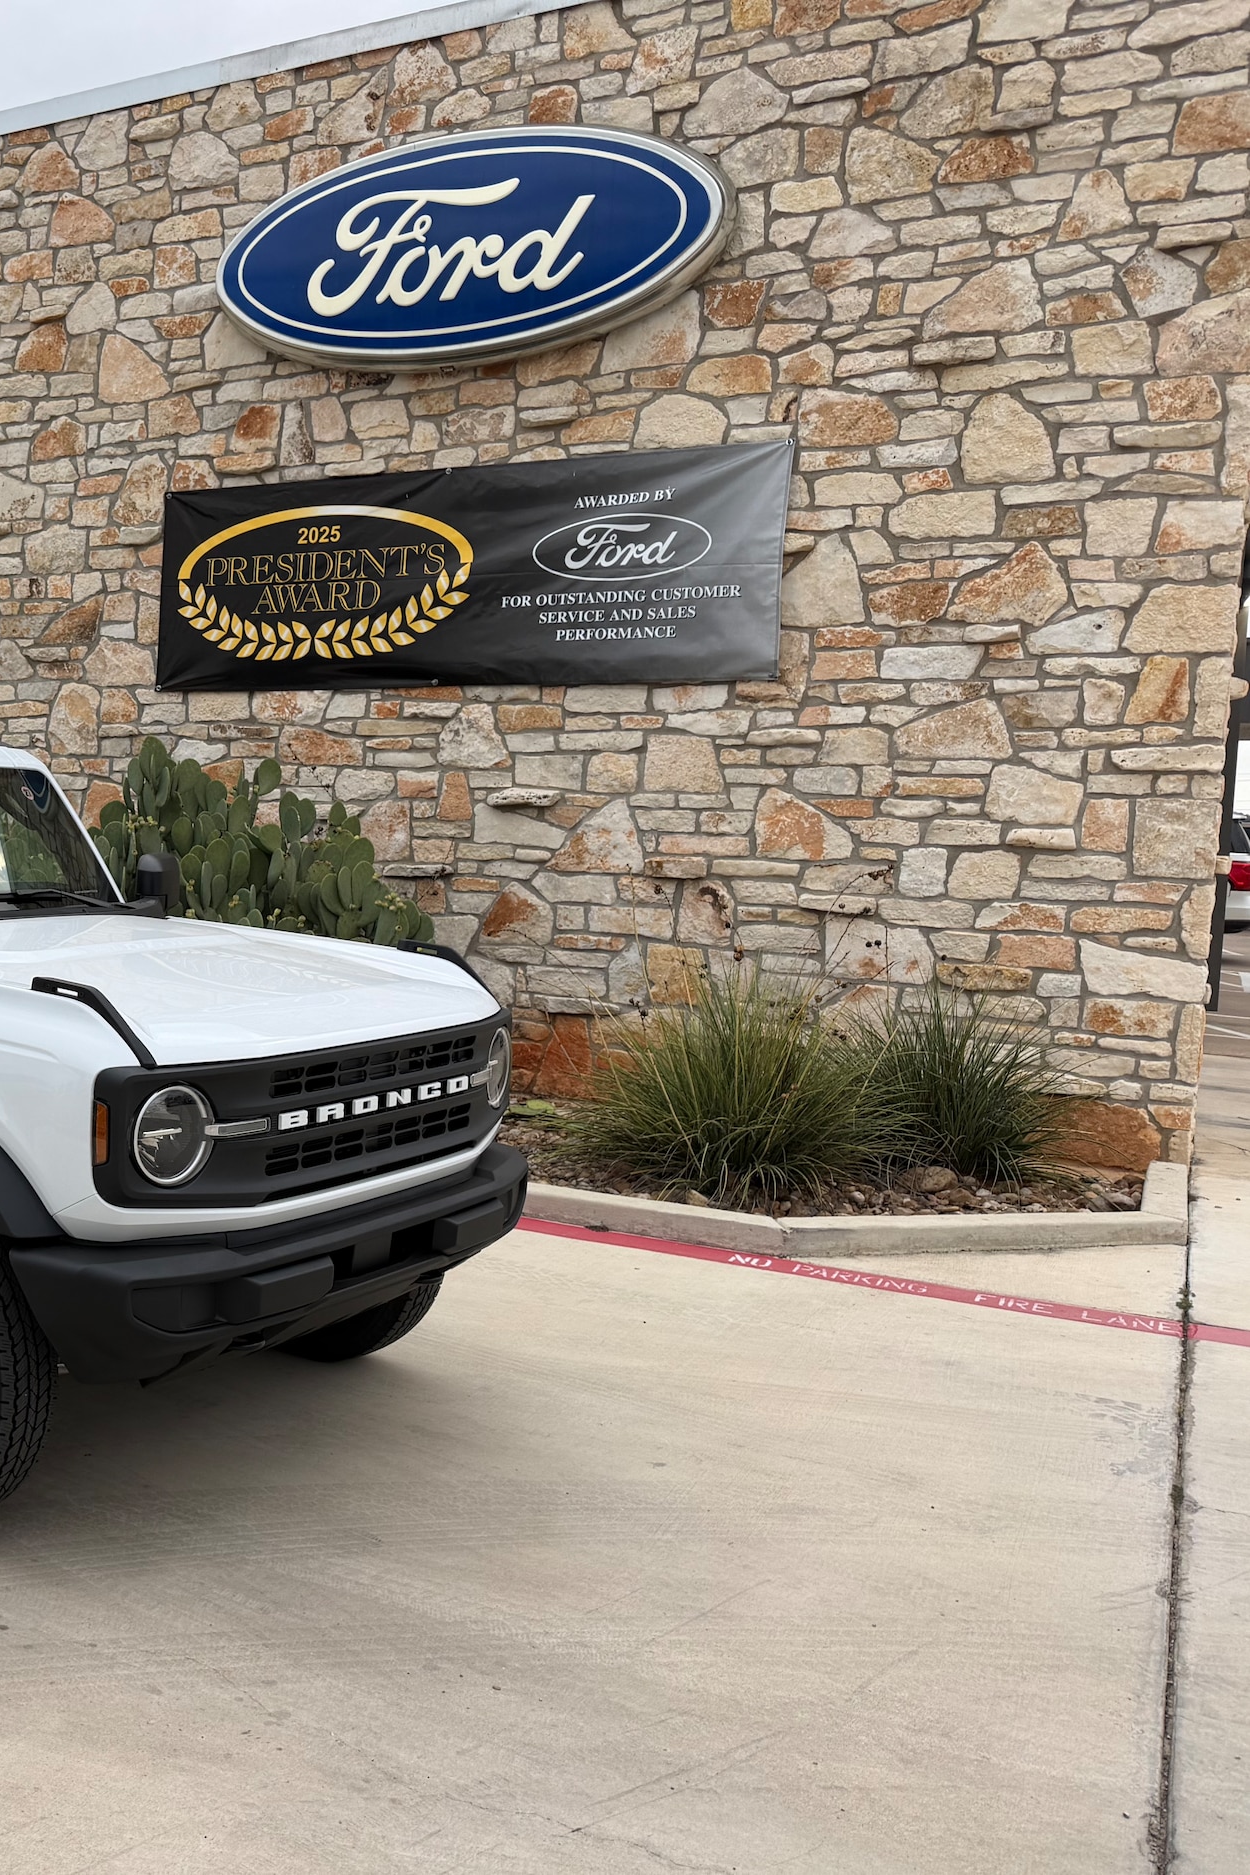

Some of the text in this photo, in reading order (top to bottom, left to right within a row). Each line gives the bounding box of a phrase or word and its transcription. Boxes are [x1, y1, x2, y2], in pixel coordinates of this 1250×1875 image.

[306, 177, 596, 317] Ford
[574, 488, 676, 509] AWARDED BY
[297, 525, 341, 545] 2025
[564, 522, 678, 570] Ford
[205, 543, 446, 586] PRESIDENT'S
[251, 580, 381, 614] AWARD
[501, 584, 742, 608] FOR OUTSTANDING CUSTOMER
[538, 605, 697, 624] SERVICE AND SALES
[555, 625, 677, 642] PERFORMANCE
[278, 1075, 470, 1131] BRONCO
[728, 1253, 1182, 1333] NO PARKING FIRE LANE
